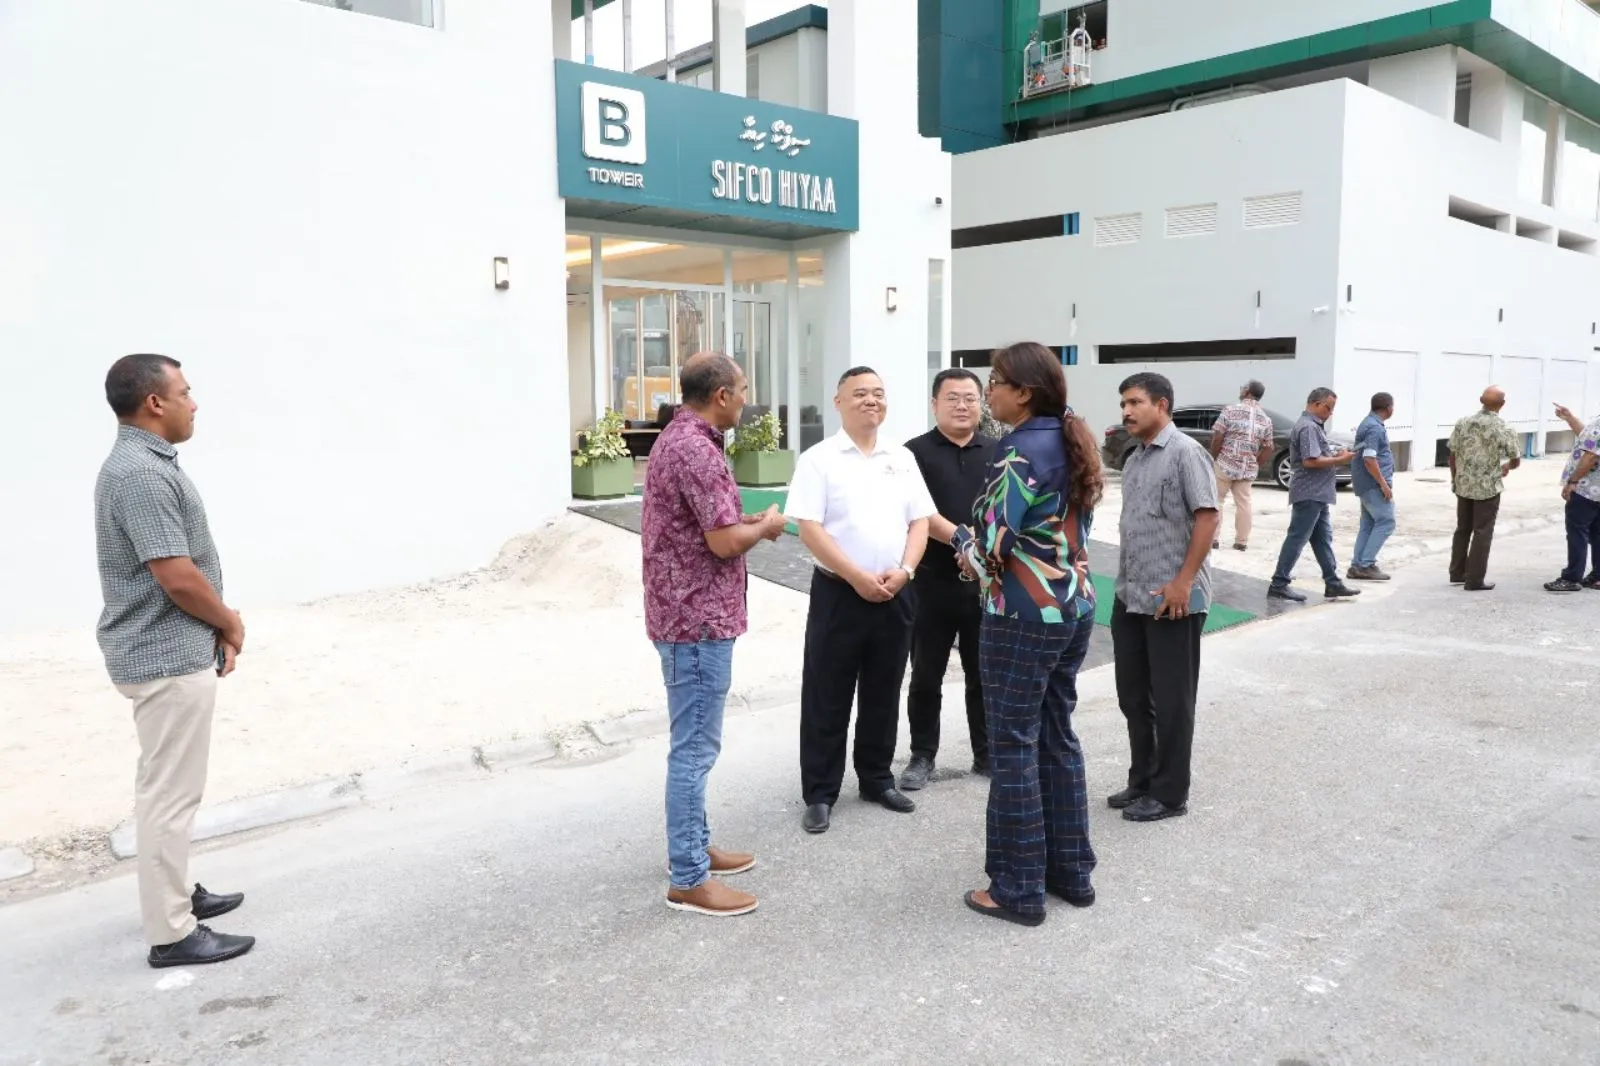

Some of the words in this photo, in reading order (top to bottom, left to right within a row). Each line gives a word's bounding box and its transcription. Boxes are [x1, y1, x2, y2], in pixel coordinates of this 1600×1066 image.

[599, 97, 632, 147] B
[587, 167, 644, 188] TOWER
[711, 159, 772, 204] SIFCO
[778, 169, 837, 213] HIYAA
